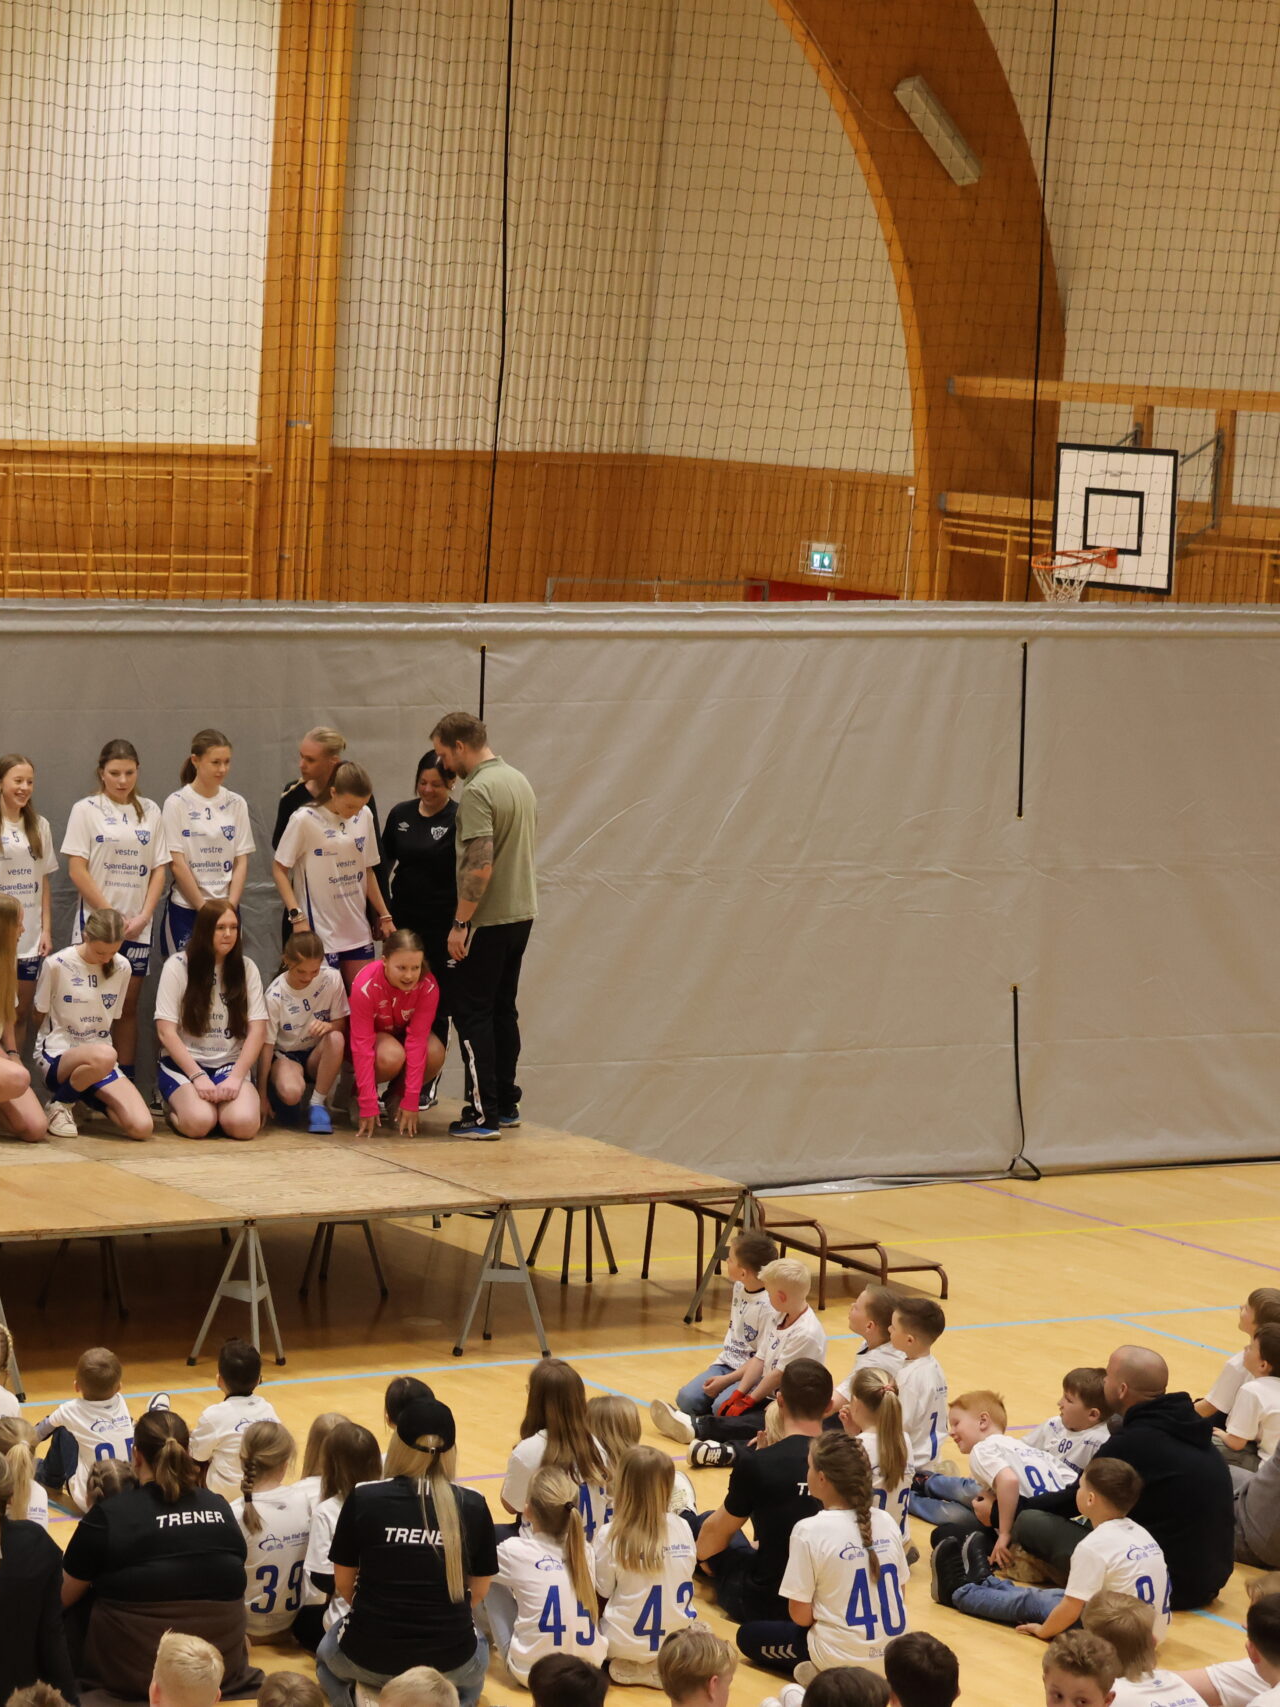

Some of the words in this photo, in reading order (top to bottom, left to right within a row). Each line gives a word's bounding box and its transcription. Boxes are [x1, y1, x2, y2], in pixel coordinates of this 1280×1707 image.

[122, 812, 128, 824] 4
[204, 808, 212, 820] 3
[12, 830, 20, 843] 5
[114, 848, 138, 856] vestre
[200, 846, 223, 854] vestre
[104, 862, 139, 870] SpareBank
[188, 860, 222, 868] SpareBank
[336, 859, 356, 868] vestre
[8, 868, 32, 876] vestre
[87, 974, 98, 988] 19
[302, 998, 311, 1012] 8
[66, 1025, 98, 1038] SpareBank
[156, 1510, 225, 1529] TRENER
[384, 1527, 445, 1546] TRENE
[250, 1560, 305, 1614] 39
[846, 1563, 906, 1640] 40
[538, 1585, 596, 1646] 45
[632, 1582, 698, 1652] 42
